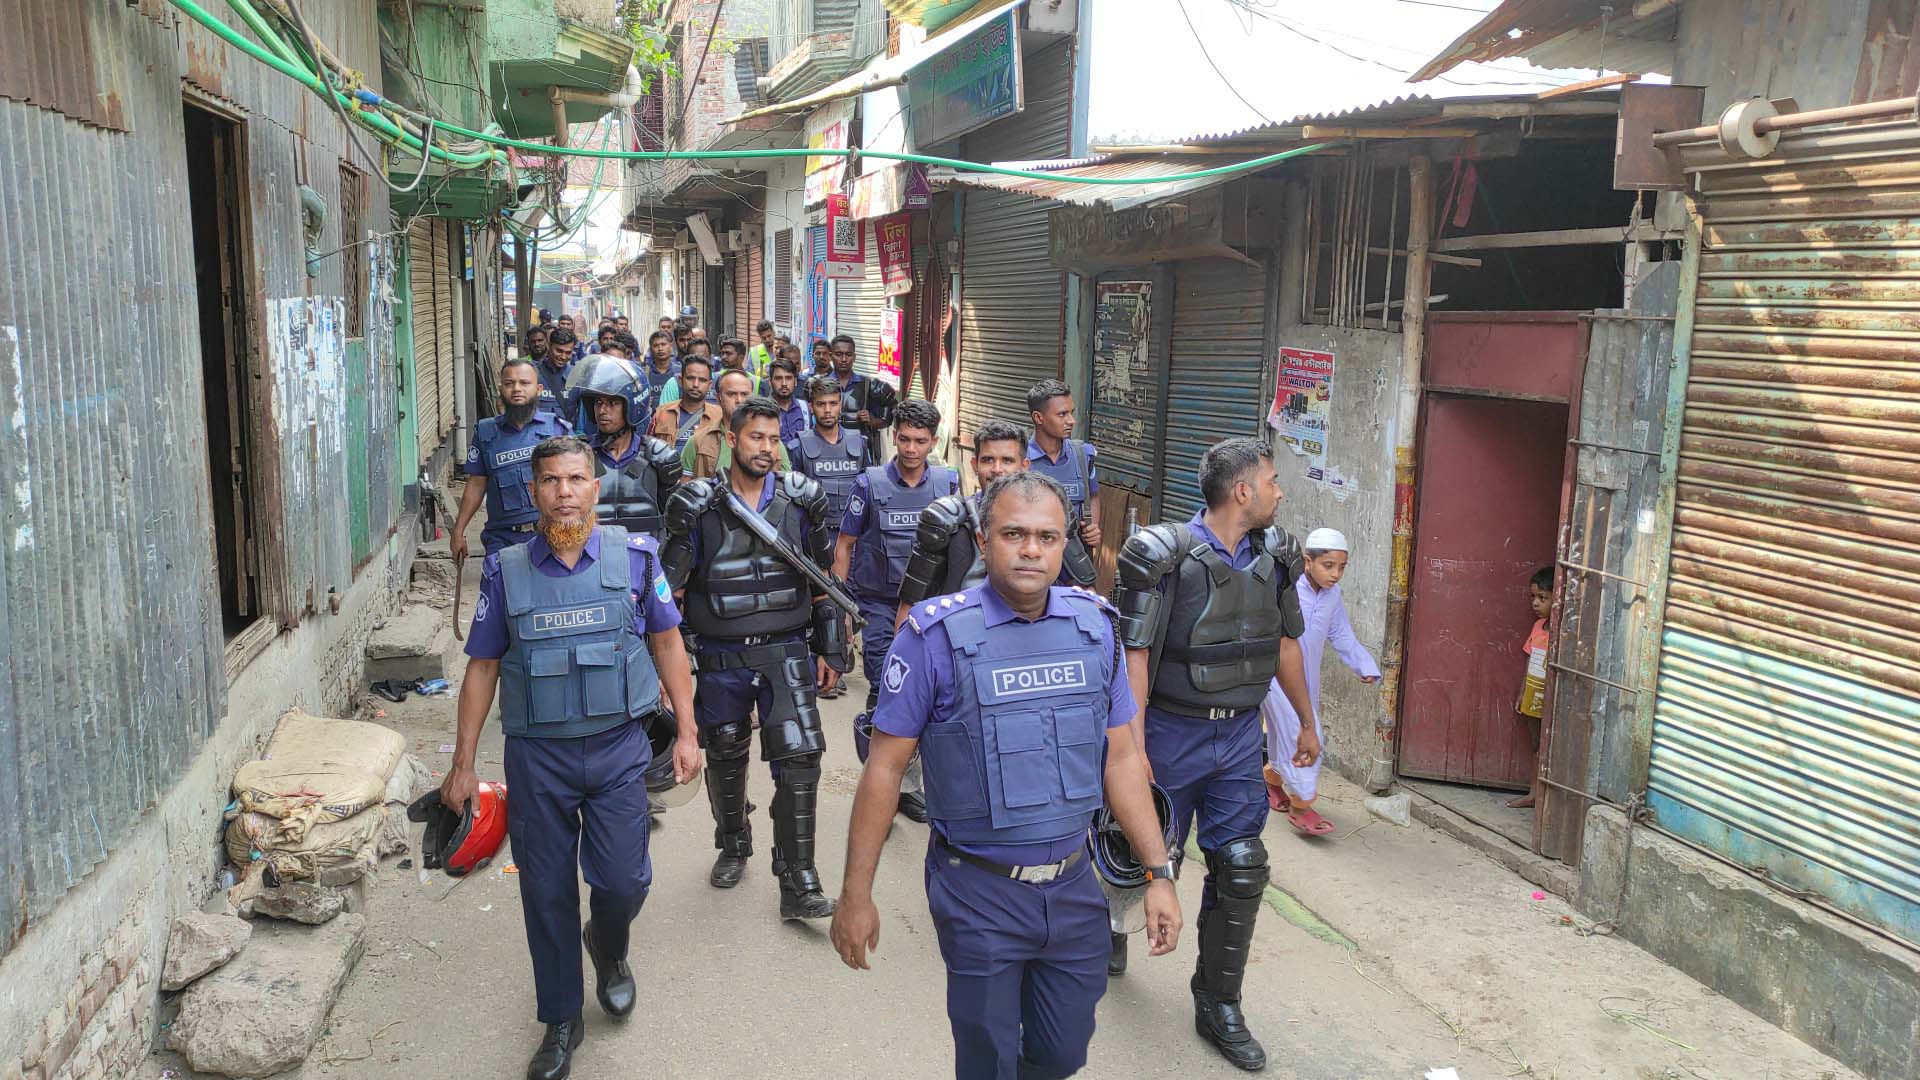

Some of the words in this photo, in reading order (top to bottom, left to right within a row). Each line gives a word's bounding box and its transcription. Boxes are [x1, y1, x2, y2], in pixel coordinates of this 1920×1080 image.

[883, 222, 906, 241] বিল
[1288, 377, 1316, 389] WALTON
[815, 460, 858, 472] POLICE
[893, 514, 921, 524] POLI
[544, 610, 594, 628] POLICE
[1002, 666, 1077, 690] POLICE
